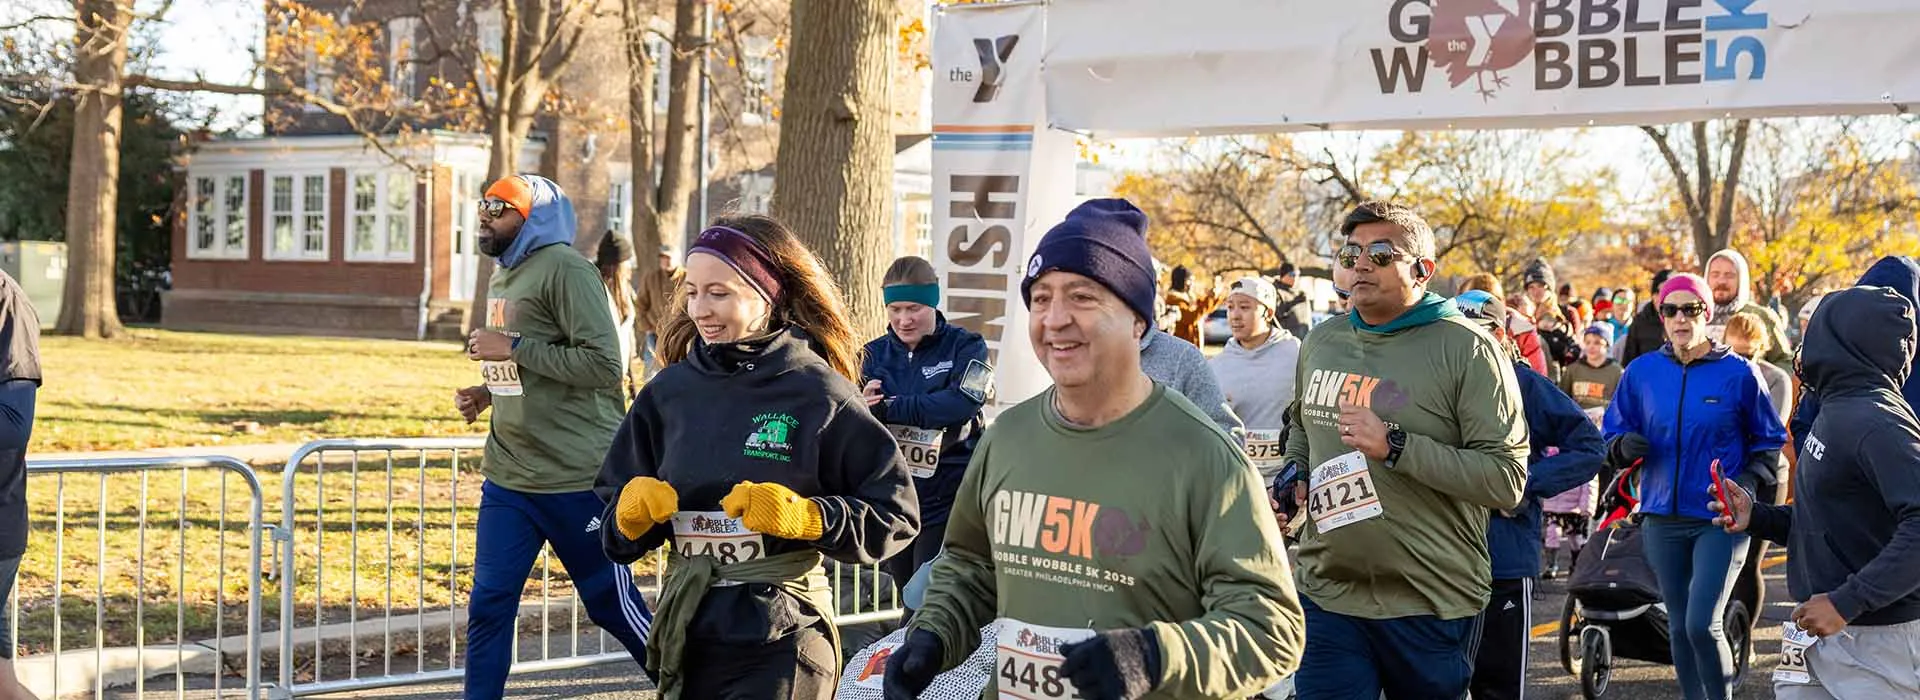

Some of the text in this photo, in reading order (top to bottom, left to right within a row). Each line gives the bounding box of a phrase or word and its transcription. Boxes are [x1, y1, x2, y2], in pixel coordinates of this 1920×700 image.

[1388, 0, 1701, 42] GBBLE
[1704, 0, 1768, 81] 5K
[1370, 34, 1701, 95] WBBLE
[1447, 39, 1467, 51] the
[949, 34, 1019, 103] the Y
[946, 174, 1020, 400] NISH
[482, 364, 518, 382] 4310
[1305, 368, 1379, 408] GW5K
[752, 412, 800, 429] WALLACE
[1304, 408, 1329, 418] GOBBLE
[1245, 444, 1281, 457] 375
[1311, 477, 1374, 515] 4121
[994, 489, 1100, 561] GW5K
[994, 551, 1028, 565] GOBBLE
[1032, 556, 1082, 574] WOBBLE
[1104, 570, 1135, 586] 2025
[1004, 566, 1115, 593] GREATER PHILADELPHIA YMCA
[1001, 656, 1070, 698] 448
